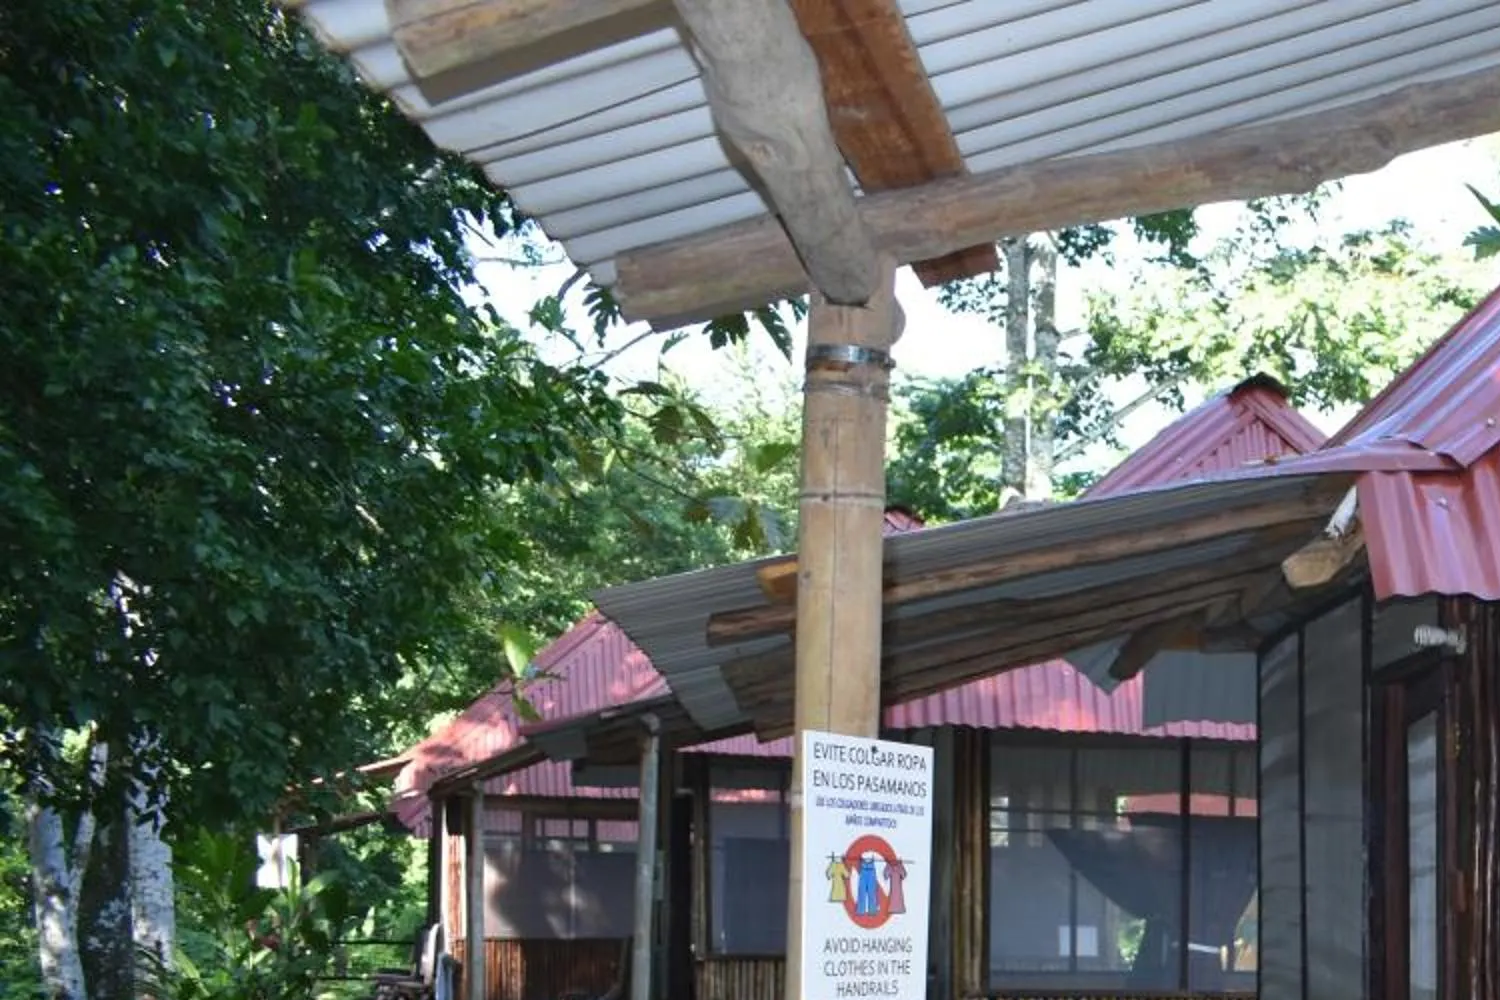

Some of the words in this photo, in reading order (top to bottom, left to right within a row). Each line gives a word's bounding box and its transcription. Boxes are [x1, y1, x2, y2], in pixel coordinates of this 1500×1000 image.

[814, 742, 846, 762] EVITE
[849, 747, 895, 768] COLGAR
[898, 753, 927, 771] ROPA
[813, 769, 829, 787] EN
[832, 771, 855, 790] LOS
[858, 775, 927, 798] PASAMANOS
[824, 938, 860, 954] AVOID
[862, 936, 913, 954] HANGING
[824, 960, 875, 977] CLOTHES
[879, 960, 888, 976] IN
[891, 959, 911, 975] THE
[836, 980, 899, 997] HANDRAILS
